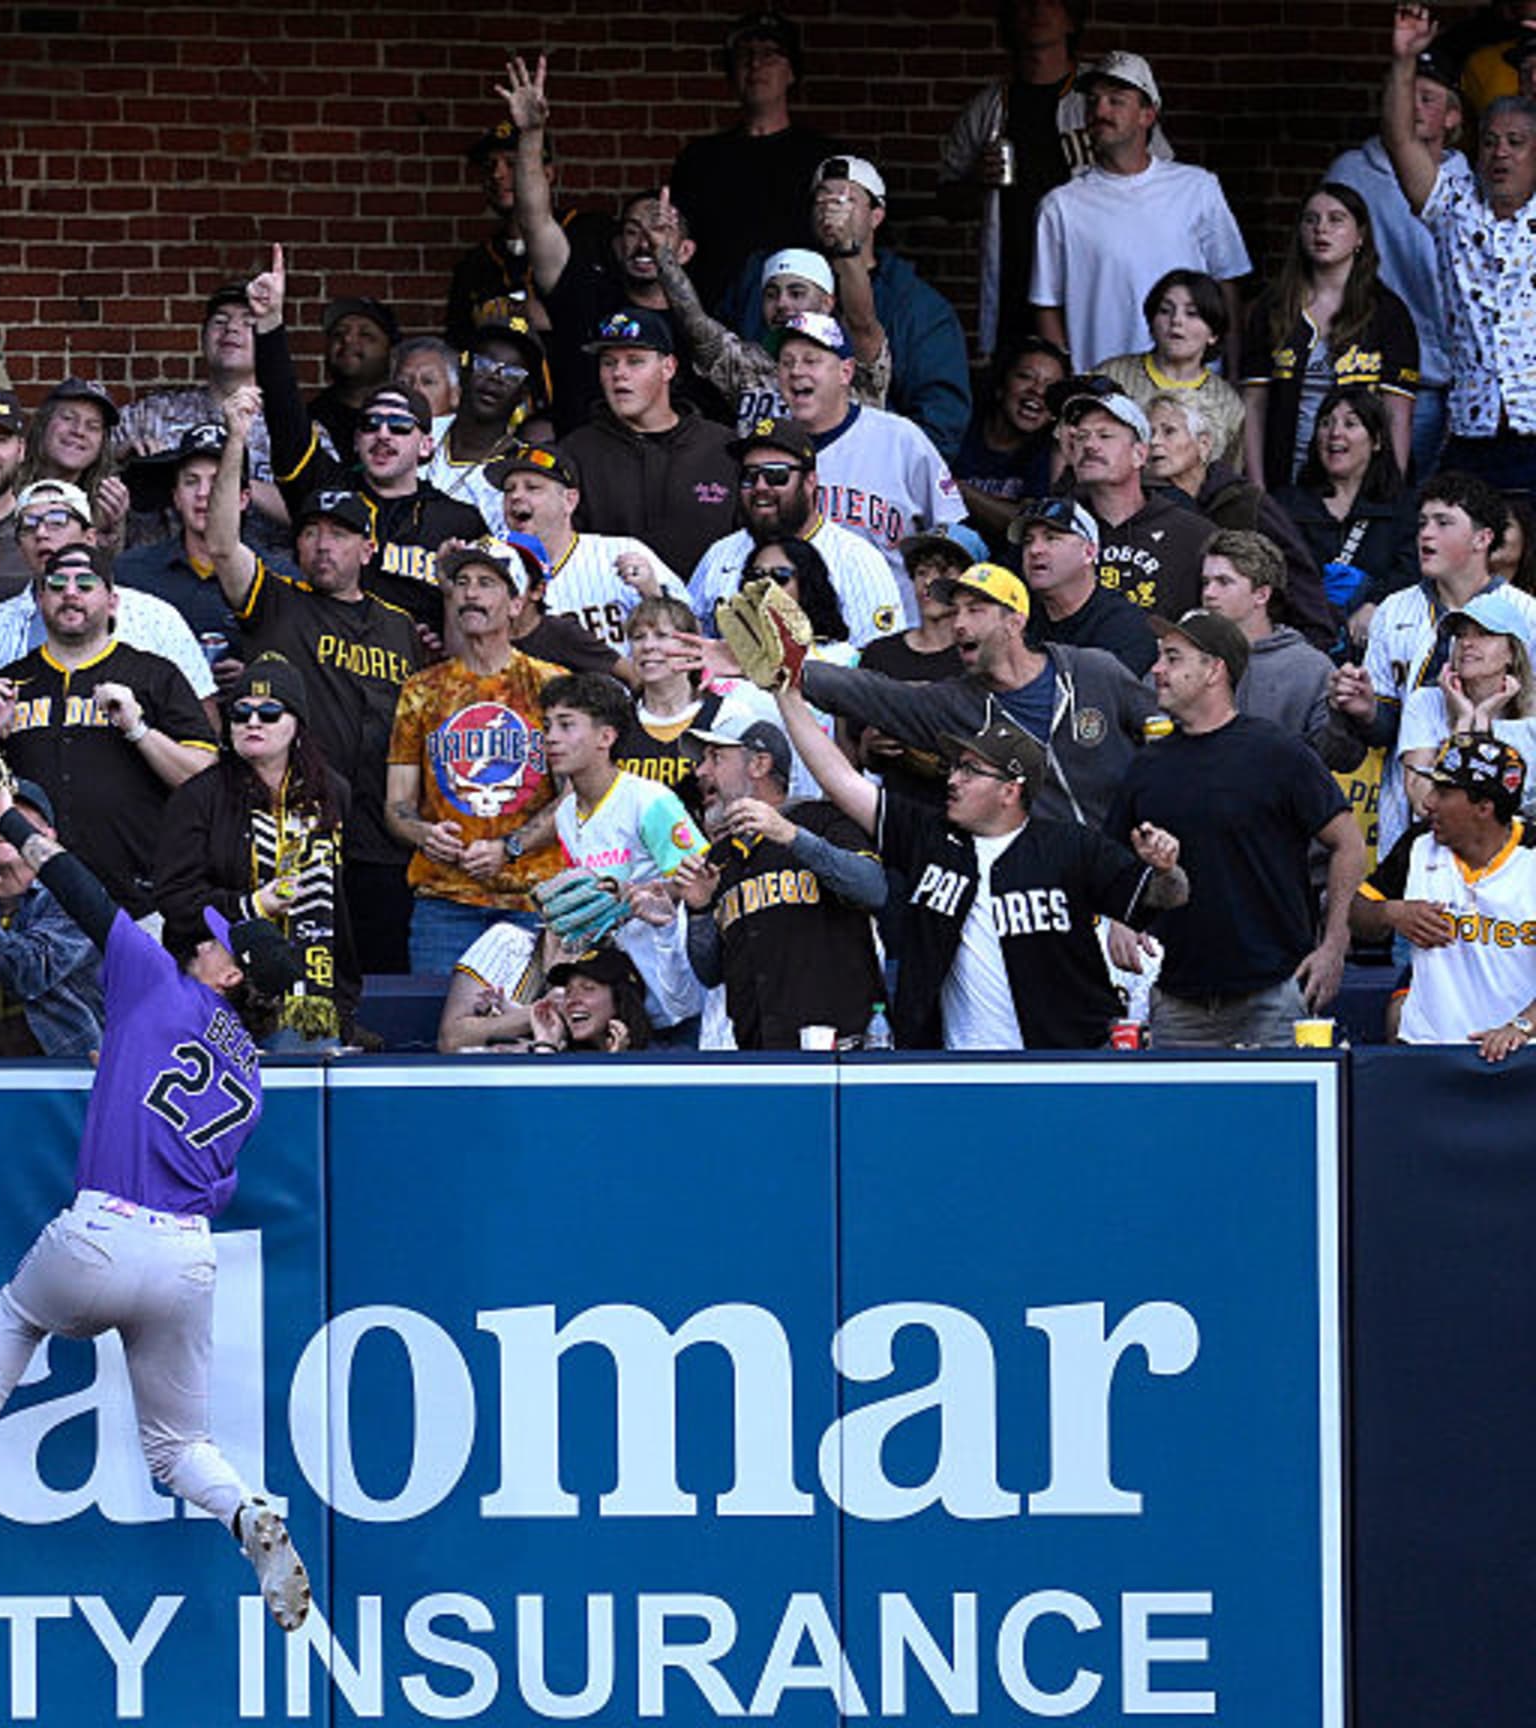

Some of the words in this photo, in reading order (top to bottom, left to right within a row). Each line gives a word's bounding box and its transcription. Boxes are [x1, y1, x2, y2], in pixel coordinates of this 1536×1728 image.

[1103, 545, 1161, 575] OBER
[11, 696, 52, 732] AN
[426, 728, 548, 774] PADRES
[740, 869, 819, 916] DIEGO
[144, 1041, 256, 1149] 27
[238, 1590, 1217, 1721] INSURANCE
